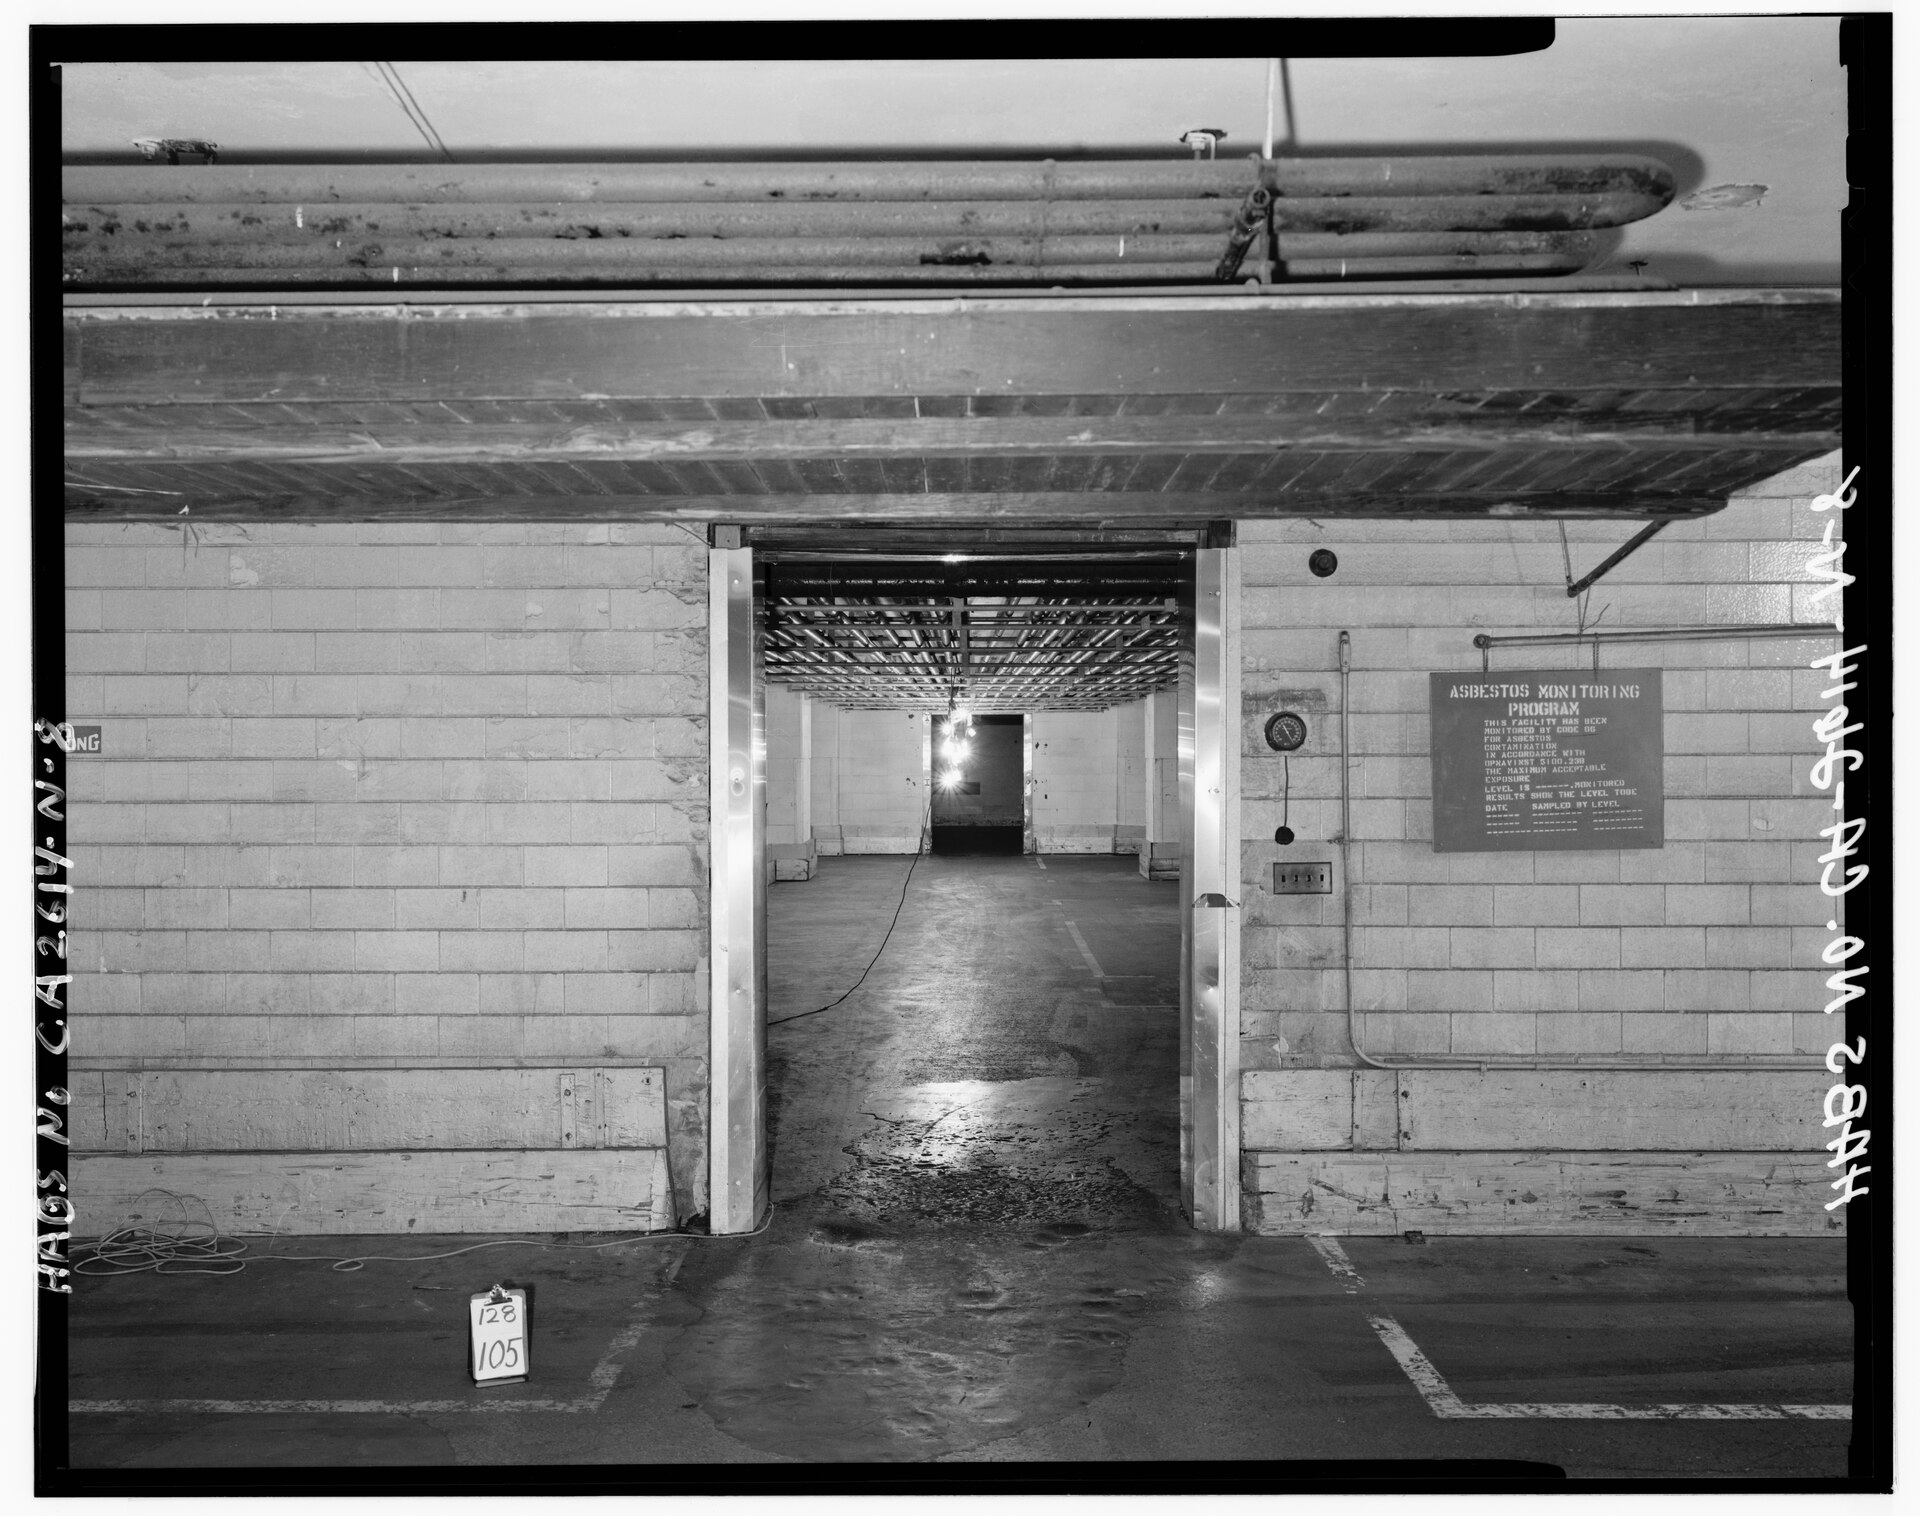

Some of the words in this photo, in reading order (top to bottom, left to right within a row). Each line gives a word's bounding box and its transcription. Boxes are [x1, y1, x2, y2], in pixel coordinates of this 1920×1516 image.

[1450, 684, 1530, 699] ASBESTOS
[1538, 684, 1641, 699] MONITORING
[1508, 702, 1580, 717] PROGRAM
[1484, 719, 1507, 727] THIS
[1511, 718, 1557, 726] FACILITY
[1484, 727, 1535, 735] MONITORED
[1539, 726, 1551, 734] BY
[70, 733, 100, 751] NG
[1484, 735, 1501, 743] FOR
[1506, 734, 1552, 742] ASBESTOS
[1484, 742, 1558, 751] CONTAMINATION
[1486, 751, 1496, 759] IN
[1501, 750, 1557, 758] ACCORDANCE
[1562, 749, 1586, 757] WITH
[1485, 767, 1502, 775] THE
[1507, 766, 1547, 774] MAXIMUM
[1552, 763, 1607, 773] ACCEPTABLE
[1485, 775, 1531, 783] EXPOSURE
[1484, 785, 1513, 793] LEVEL
[1519, 784, 1530, 792] IS
[1486, 792, 1526, 801] RESULTS
[1530, 791, 1554, 800] SHOW
[1558, 790, 1576, 798] THE
[1580, 789, 1609, 798] LEVEL
[1485, 803, 1508, 812] DATE
[1532, 801, 1571, 810] SAMPLED
[1591, 800, 1620, 808] LEVEL
[479, 1305, 517, 1326] 128
[479, 1337, 523, 1372] 105
